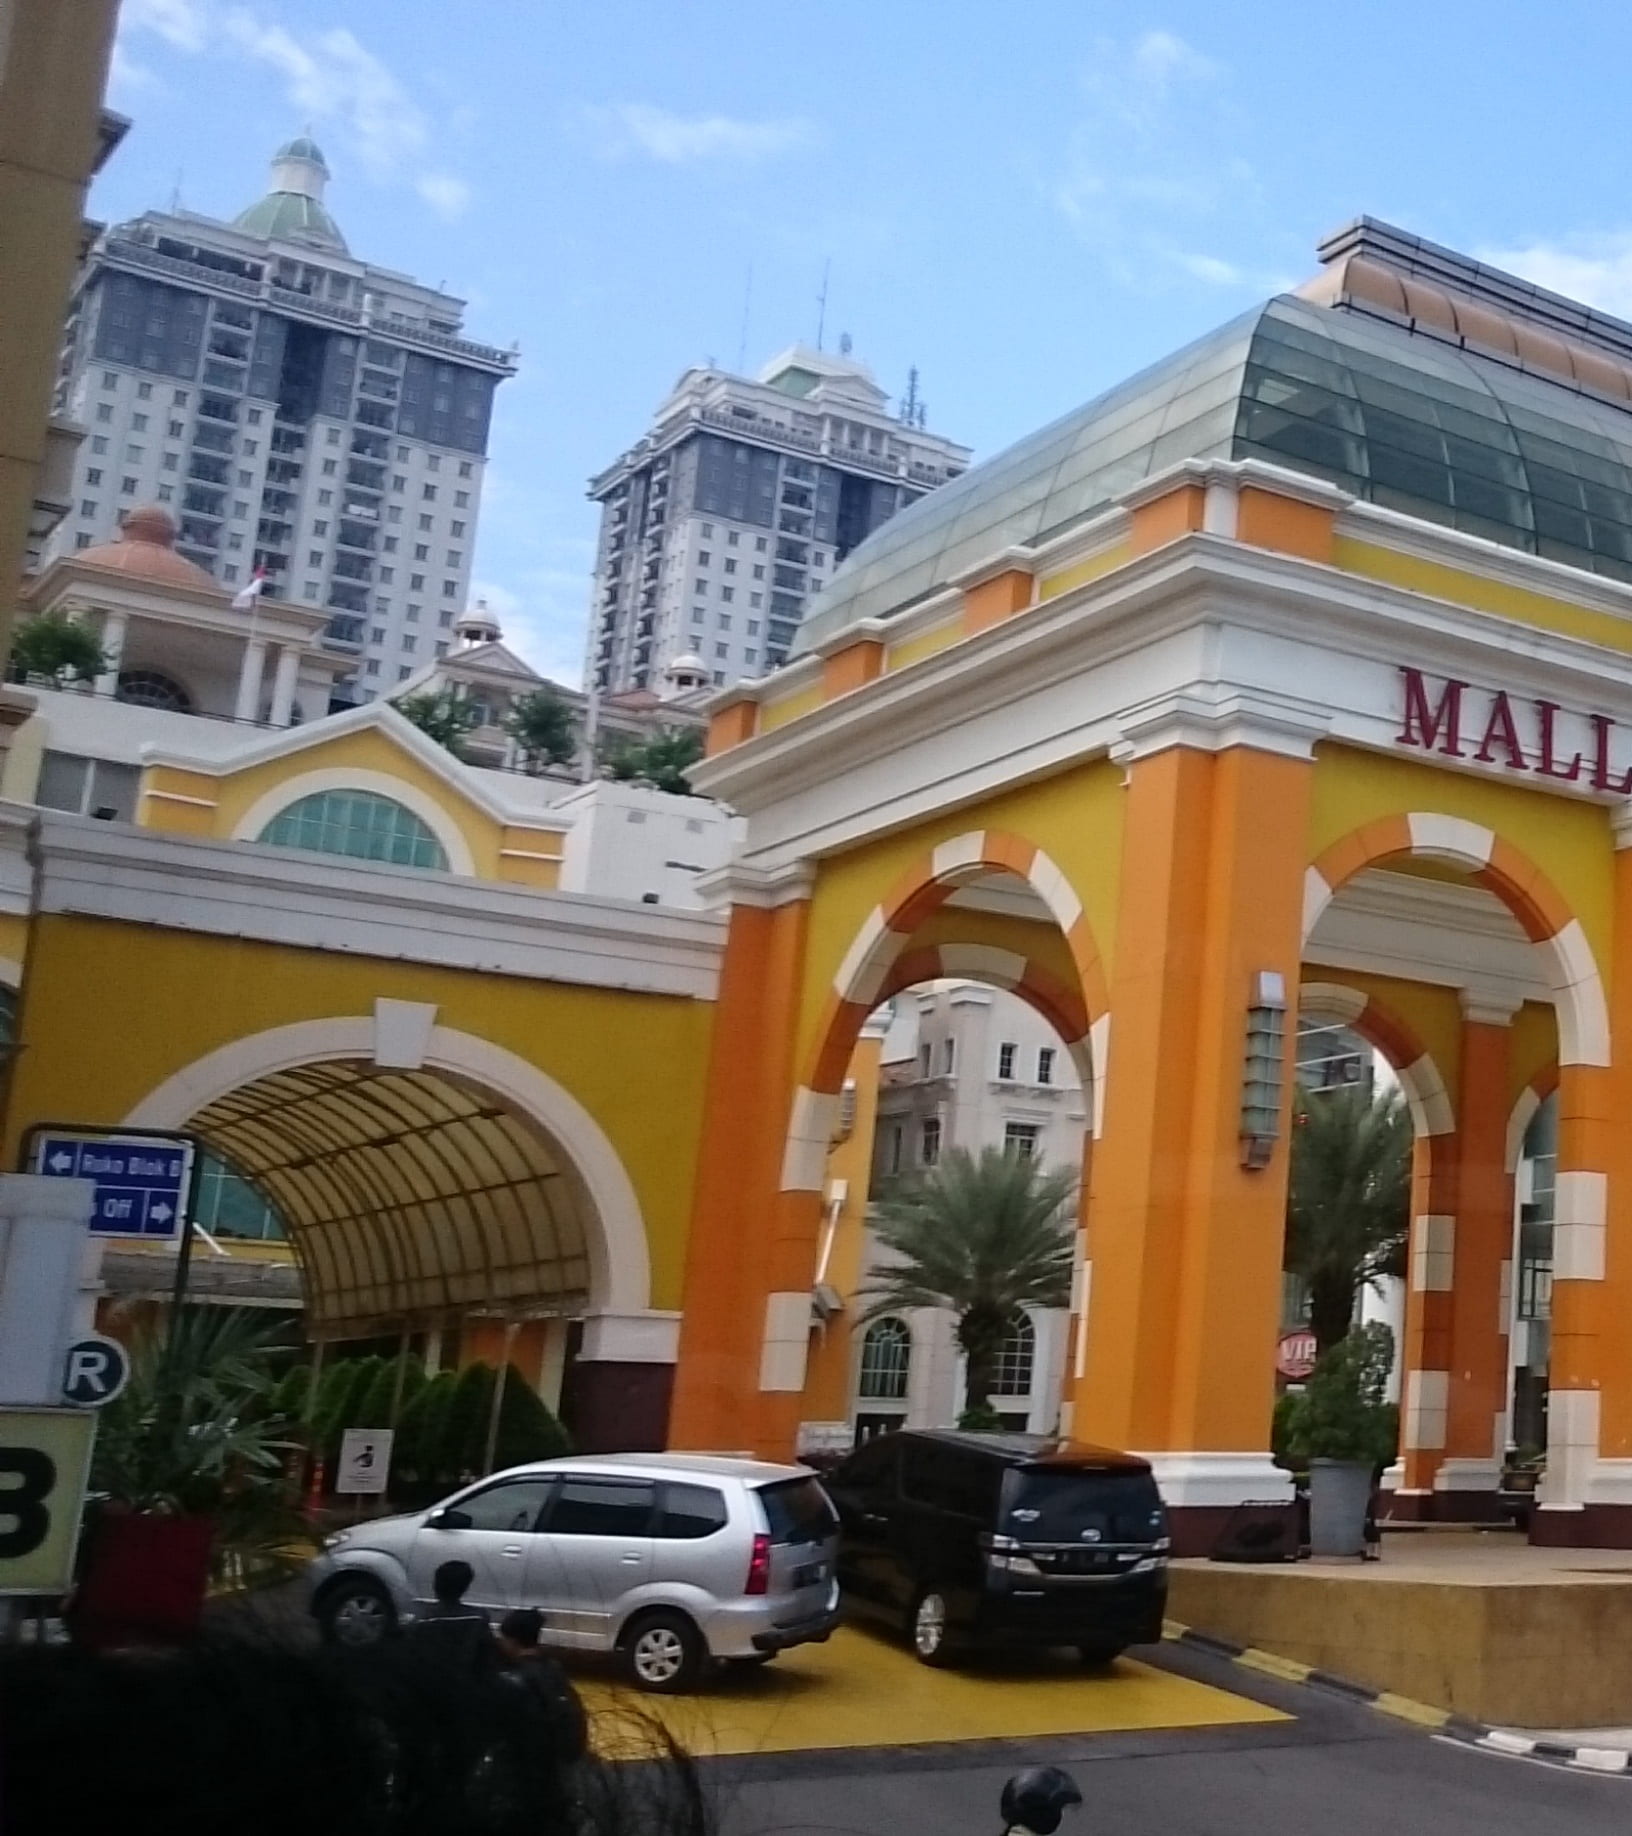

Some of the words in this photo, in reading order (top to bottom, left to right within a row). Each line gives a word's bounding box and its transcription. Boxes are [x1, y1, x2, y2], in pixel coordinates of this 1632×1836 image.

[102, 1198, 133, 1219] Off
[1281, 1337, 1317, 1361] VIP
[66, 1350, 110, 1393] R
